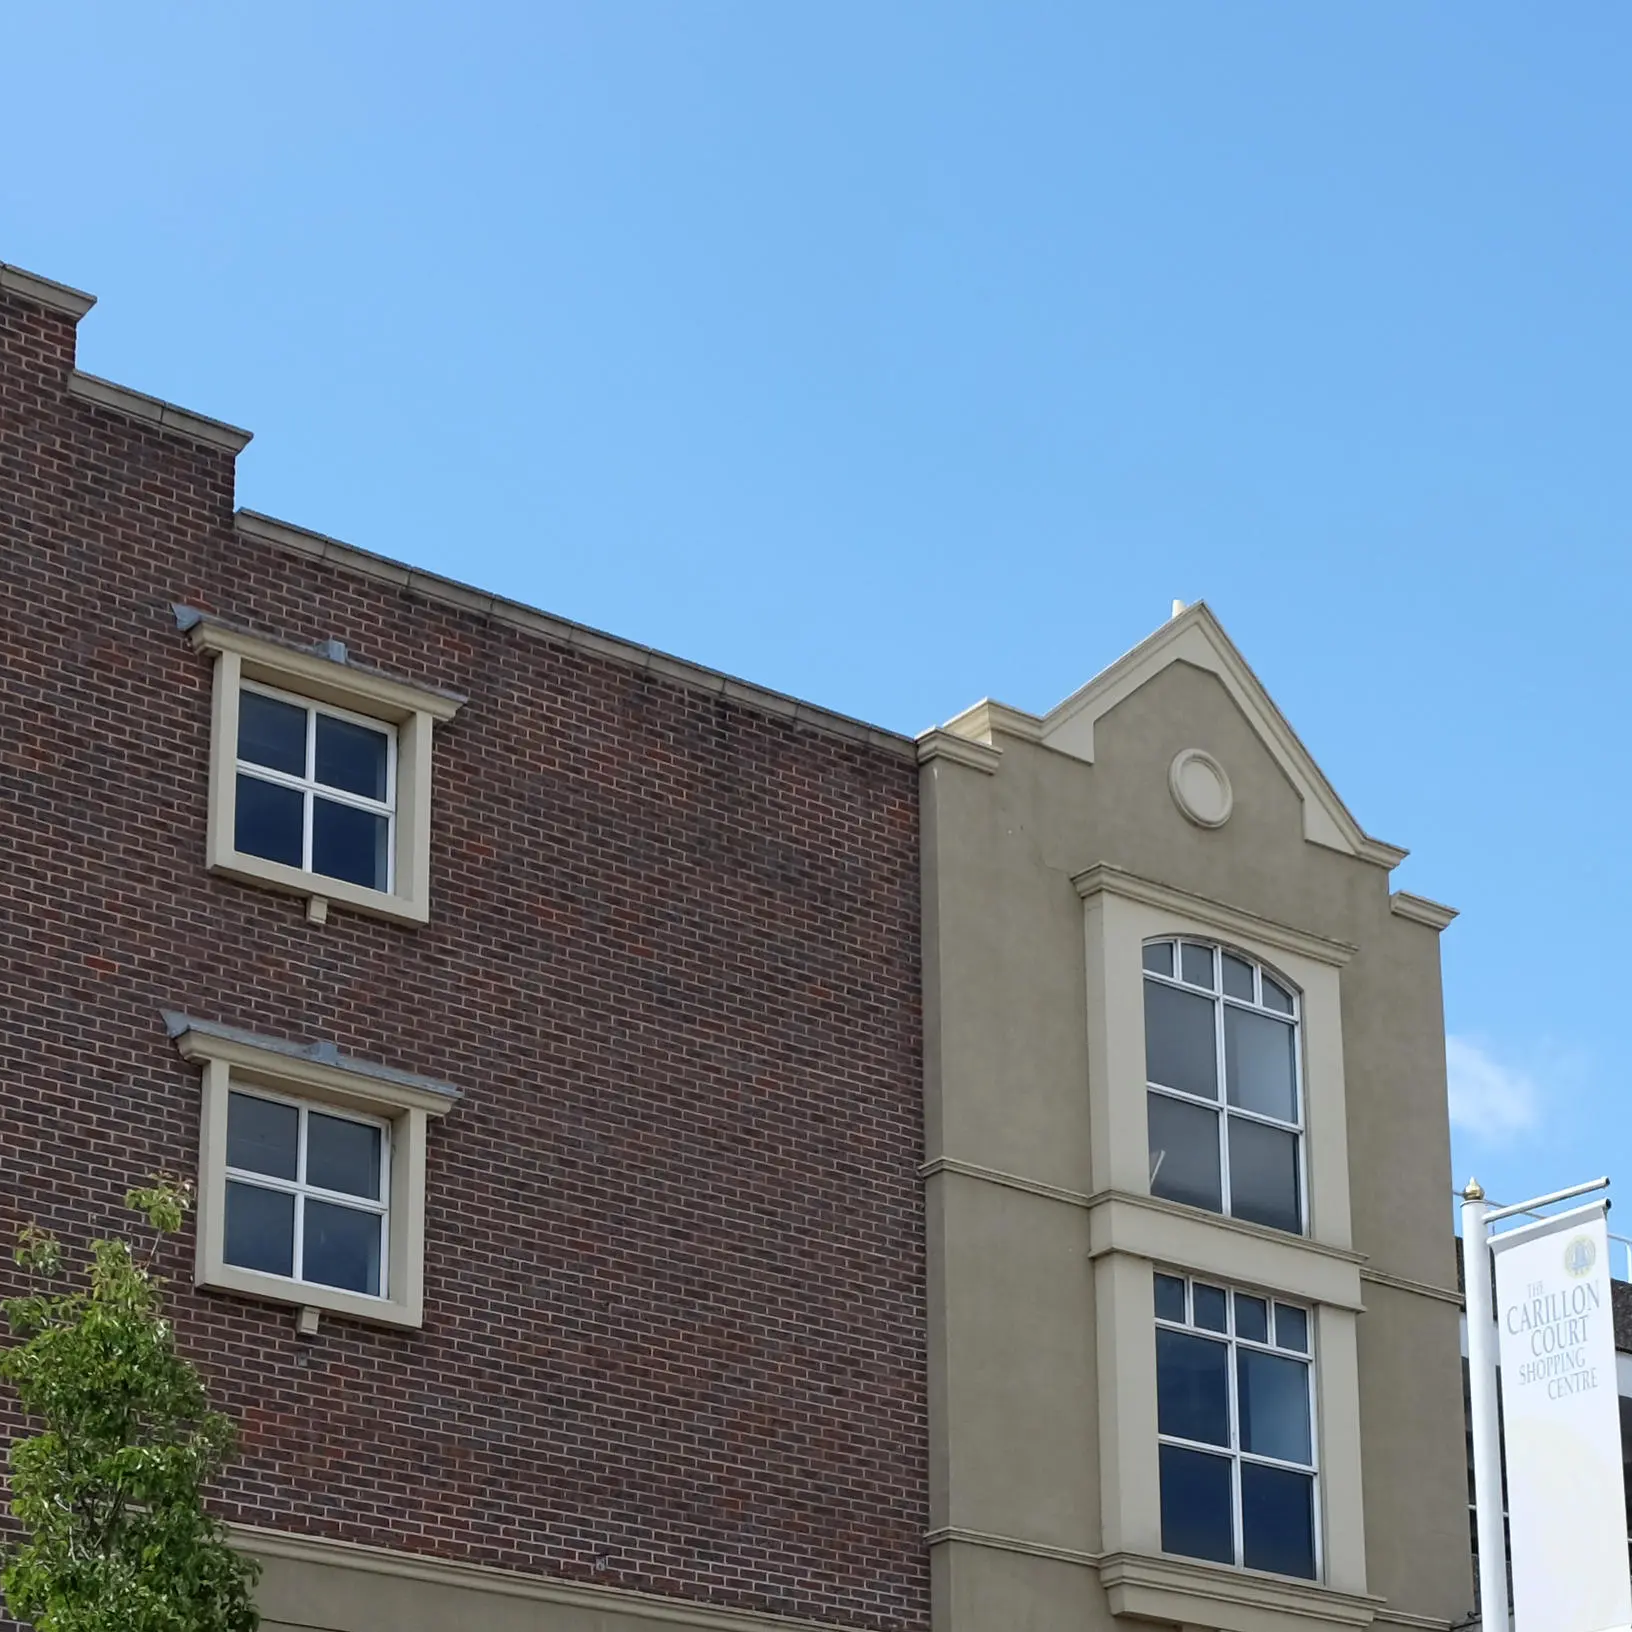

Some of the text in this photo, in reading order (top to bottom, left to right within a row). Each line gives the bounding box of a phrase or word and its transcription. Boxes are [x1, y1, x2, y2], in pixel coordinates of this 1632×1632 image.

[1506, 1279, 1600, 1336] CARILLON
[1526, 1280, 1544, 1298] THE
[1531, 1315, 1588, 1357] COURT
[1517, 1346, 1586, 1386] SHOPPING
[1547, 1367, 1599, 1400] CENTRE
